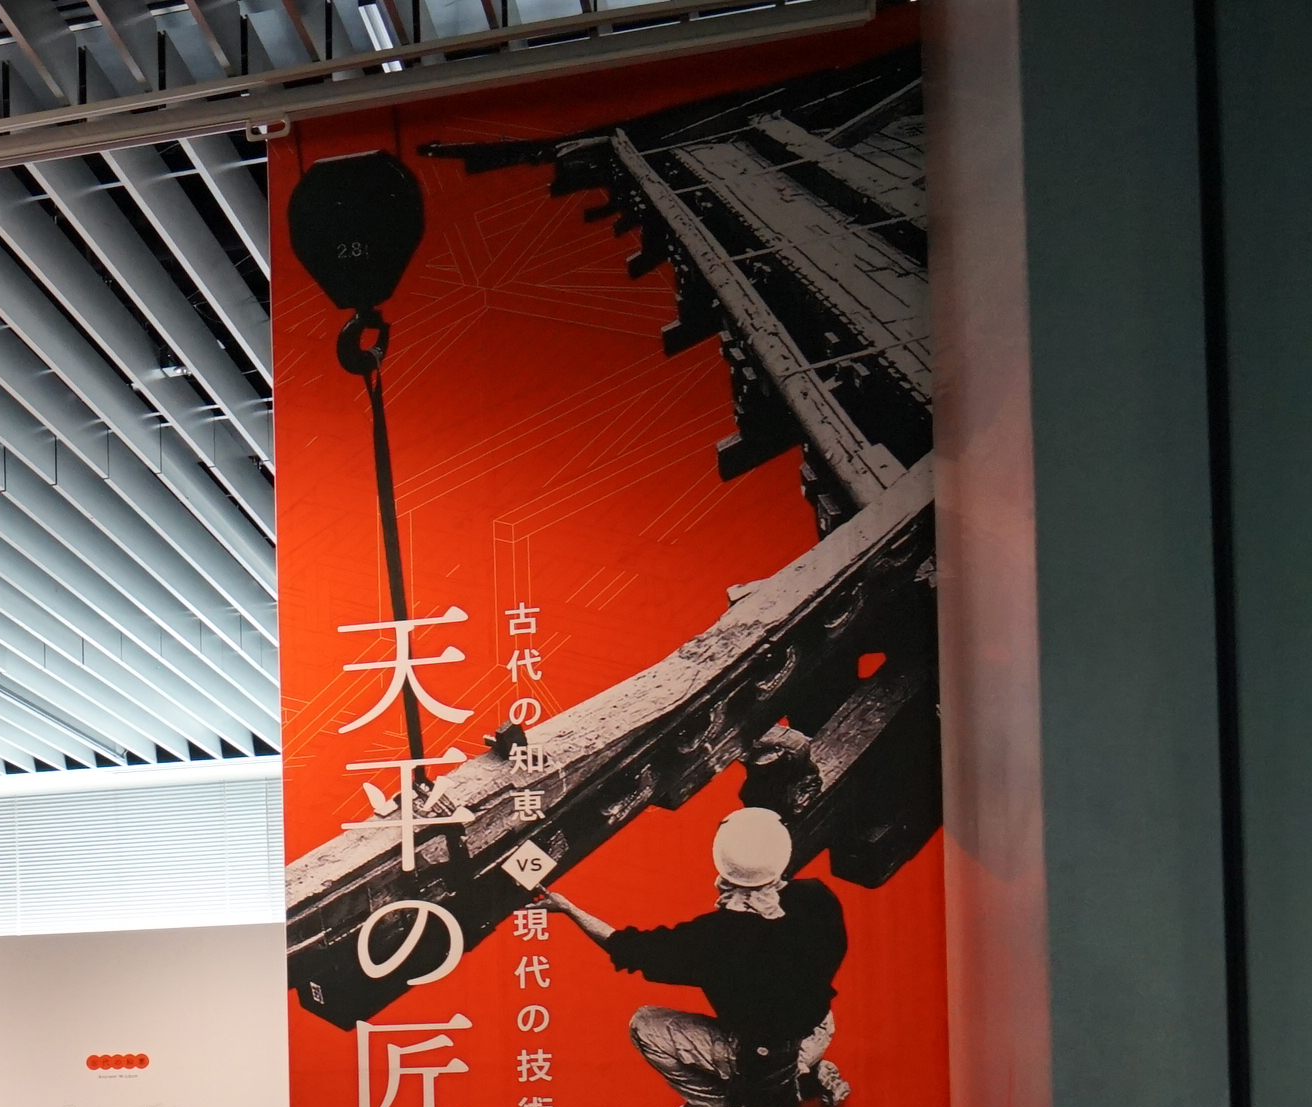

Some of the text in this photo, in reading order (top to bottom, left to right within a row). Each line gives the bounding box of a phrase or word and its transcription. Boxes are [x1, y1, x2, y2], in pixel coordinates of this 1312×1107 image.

[505, 603, 545, 822] 古代の知恵
